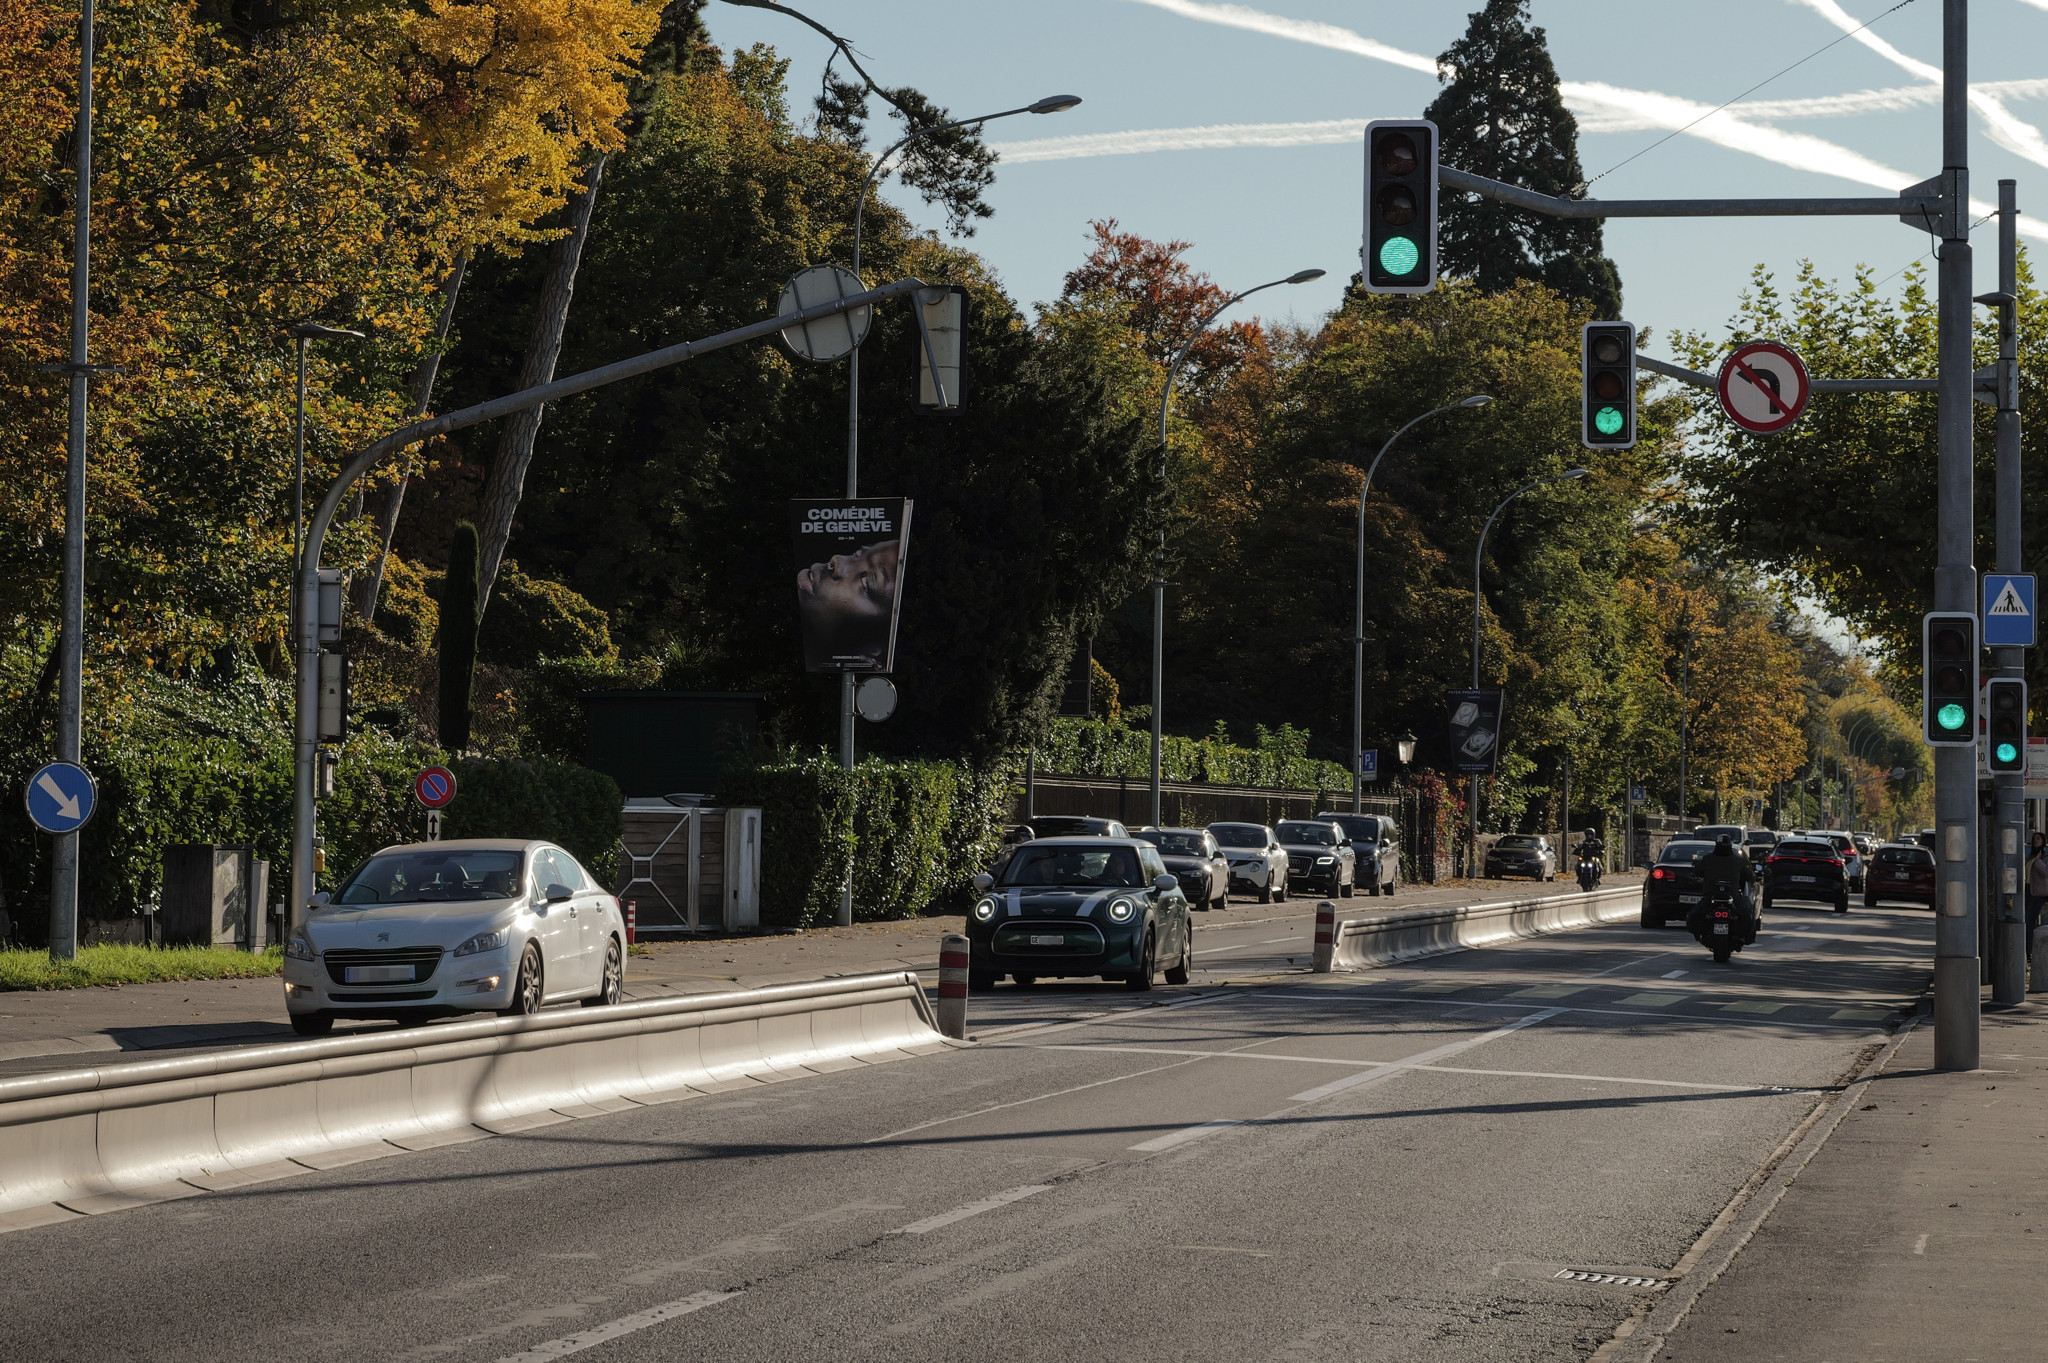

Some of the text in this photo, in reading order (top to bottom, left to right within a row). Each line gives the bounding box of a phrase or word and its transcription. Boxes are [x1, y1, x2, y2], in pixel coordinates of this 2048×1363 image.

[808, 506, 885, 520] COMÉDIE
[801, 519, 892, 533] DE GENÈVE
[1365, 753, 1371, 766] P
